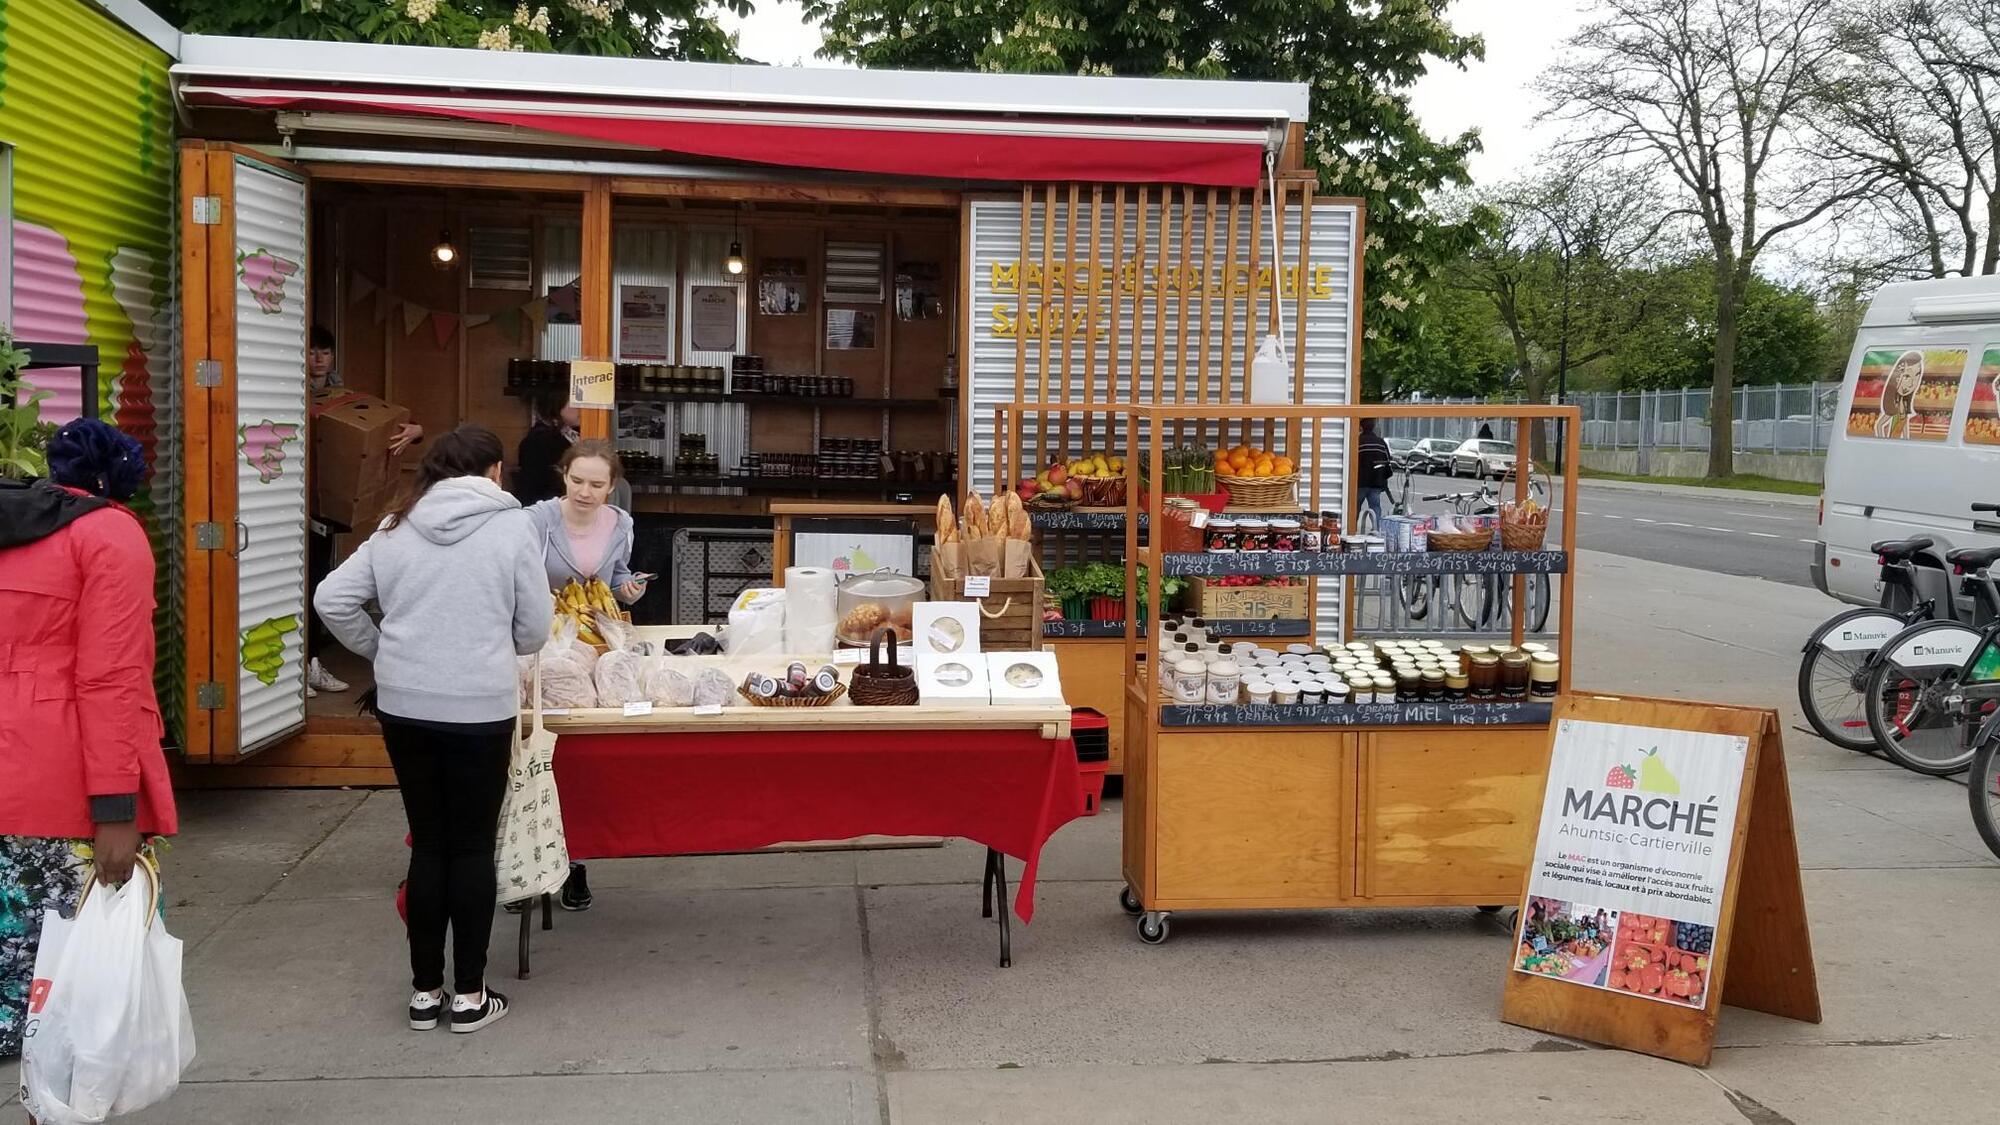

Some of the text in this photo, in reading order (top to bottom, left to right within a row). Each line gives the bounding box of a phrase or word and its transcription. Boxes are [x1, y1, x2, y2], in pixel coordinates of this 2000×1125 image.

[572, 373, 613, 387] Interac
[1103, 619, 1142, 629] Laite
[1854, 632, 1888, 641] Manuvie
[1925, 646, 1963, 656] Manuvie
[1562, 787, 1718, 837] MARCHÉ
[1558, 823, 1712, 856] Ahuntsic-Cartierville
[1545, 860, 1571, 872] sociale
[1571, 864, 1585, 874] qui
[1586, 866, 1600, 876] vise
[1608, 870, 1646, 884] améliorer
[1647, 875, 1673, 887] l'accès
[1674, 880, 1690, 889] aux
[1691, 881, 1714, 895] fruits
[1558, 851, 1703, 882] Le MAC est un organisme d'économie
[1551, 871, 1584, 884] légumes
[1585, 876, 1604, 888] frais,
[1604, 879, 1630, 892] locaux
[1631, 884, 1640, 892] et
[1647, 886, 1664, 898] prix
[1664, 890, 1713, 905] abordables.
